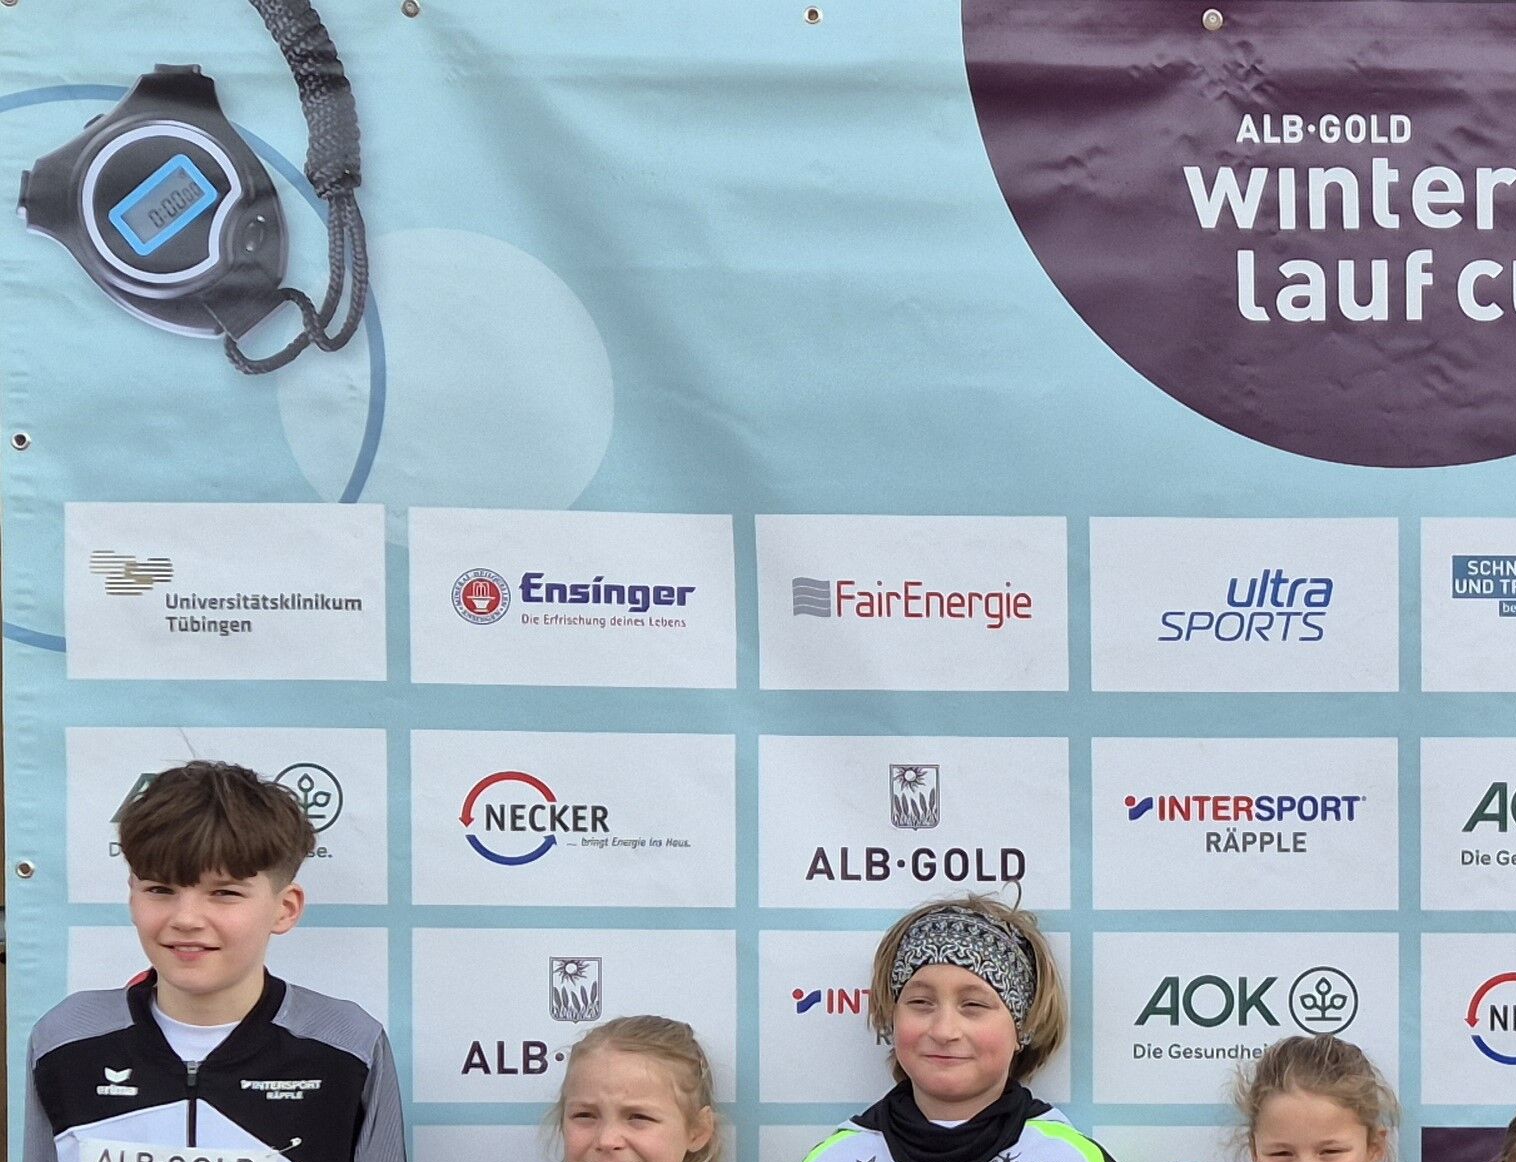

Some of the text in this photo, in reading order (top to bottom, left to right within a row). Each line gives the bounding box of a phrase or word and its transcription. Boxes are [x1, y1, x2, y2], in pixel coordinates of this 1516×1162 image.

[1237, 249, 1434, 323] lauf
[519, 572, 697, 613] Ensinger
[1227, 569, 1334, 608] ultra
[1454, 578, 1494, 595] UND
[165, 592, 363, 613] Universitätsklinikum
[836, 580, 1032, 628] FairEnergie
[166, 614, 253, 636] Tübingen
[521, 613, 687, 629] Die Erfrischung deines Lebens
[1157, 611, 1325, 642] SPORTS
[485, 804, 610, 833] NECKER
[1159, 795, 1360, 822] INTERSPORT
[611, 837, 647, 850] Energie
[1205, 828, 1308, 854] RÄPPLE
[805, 847, 1027, 883] ALB·GOLD
[1461, 849, 1492, 867] Die
[1134, 974, 1281, 1028] AOK
[1134, 1043, 1163, 1060] Die
